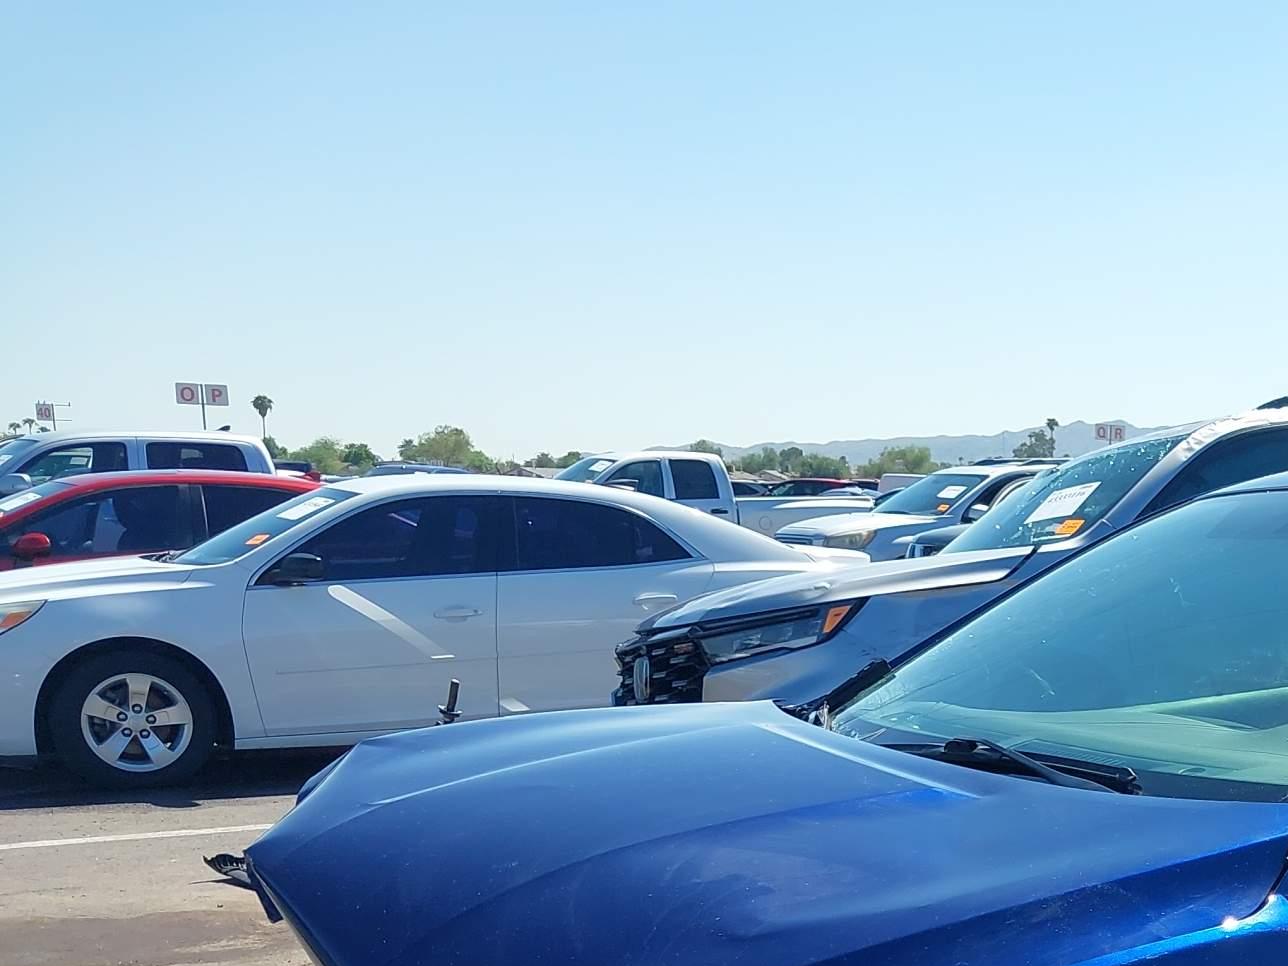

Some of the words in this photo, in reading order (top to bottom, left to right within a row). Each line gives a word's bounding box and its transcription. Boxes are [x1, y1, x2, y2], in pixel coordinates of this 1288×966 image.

[180, 387, 195, 402] O
[211, 388, 222, 403] P
[36, 407, 51, 418] 40
[1114, 427, 1122, 439] R
